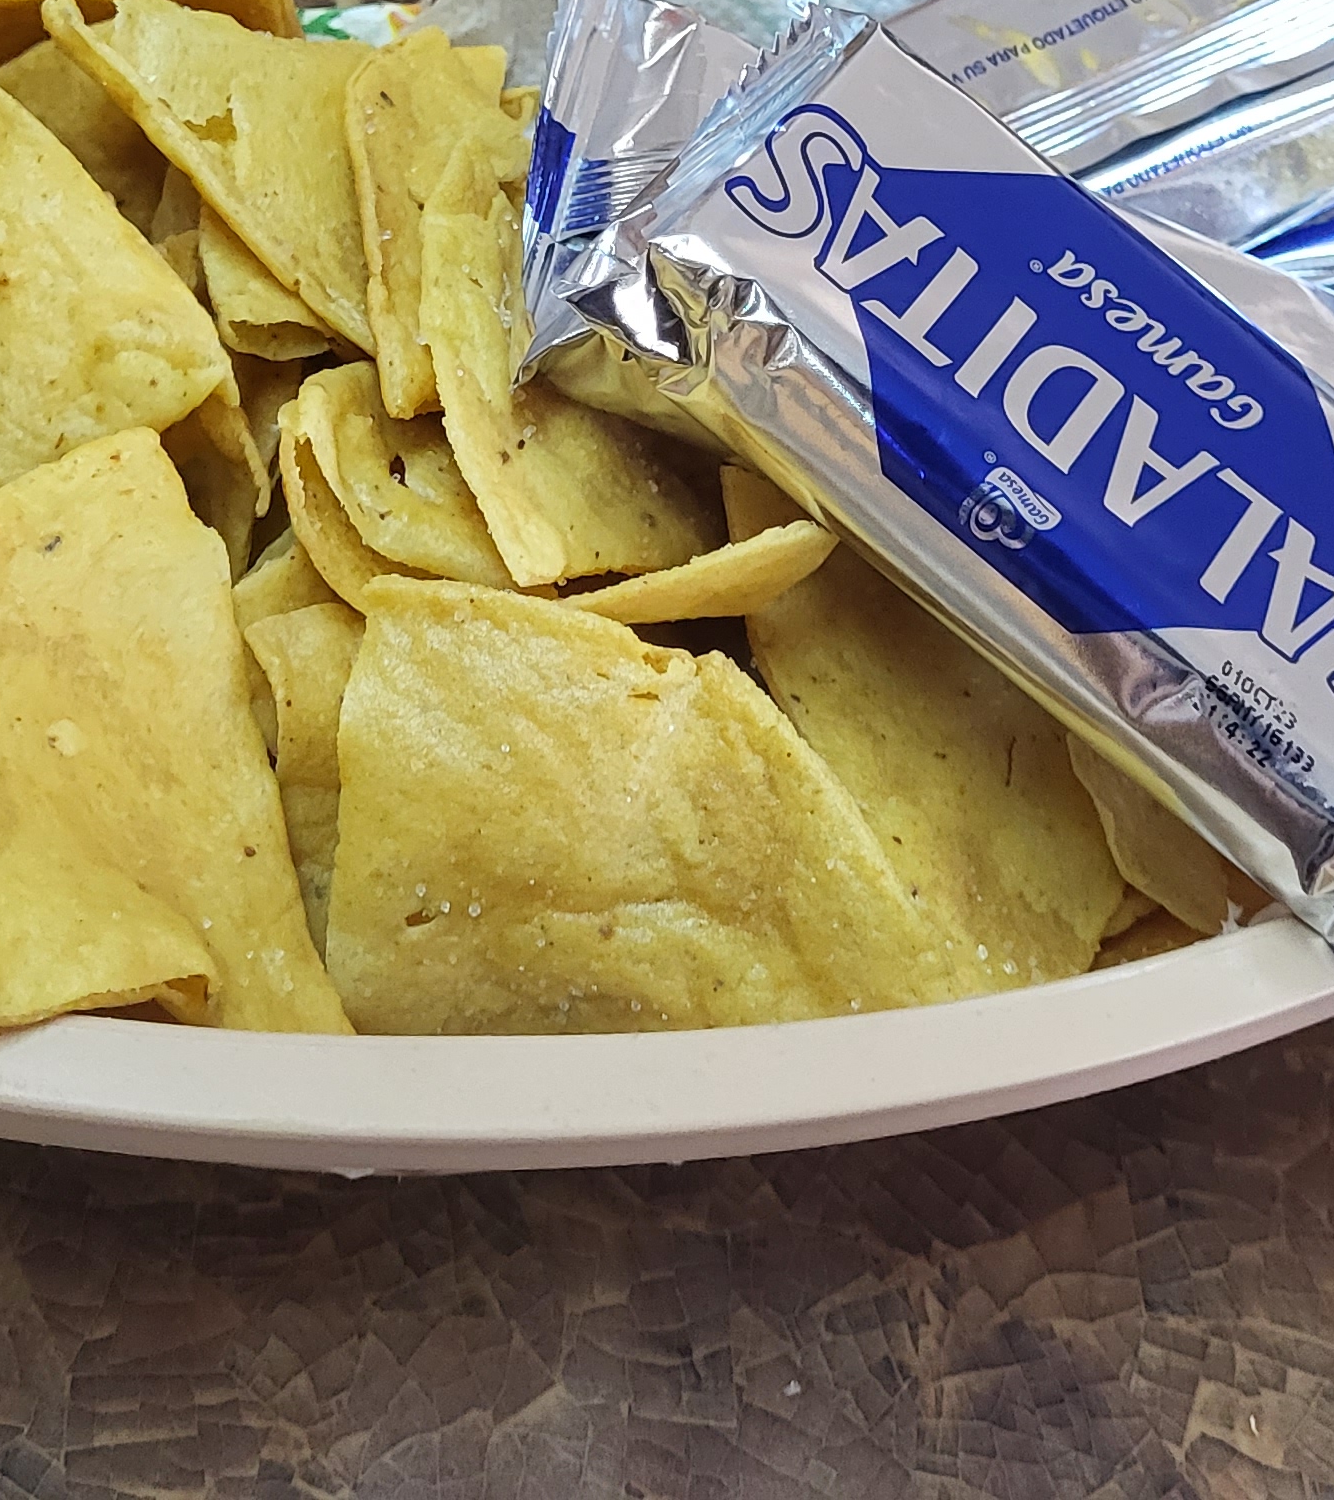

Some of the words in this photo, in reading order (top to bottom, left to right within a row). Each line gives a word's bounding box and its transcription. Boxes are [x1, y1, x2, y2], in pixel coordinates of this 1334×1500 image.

[963, 59, 988, 81] SU
[985, 43, 1032, 68] PARA
[1046, 247, 1265, 430] Gamesa
[997, 471, 1050, 525] Gamesa
